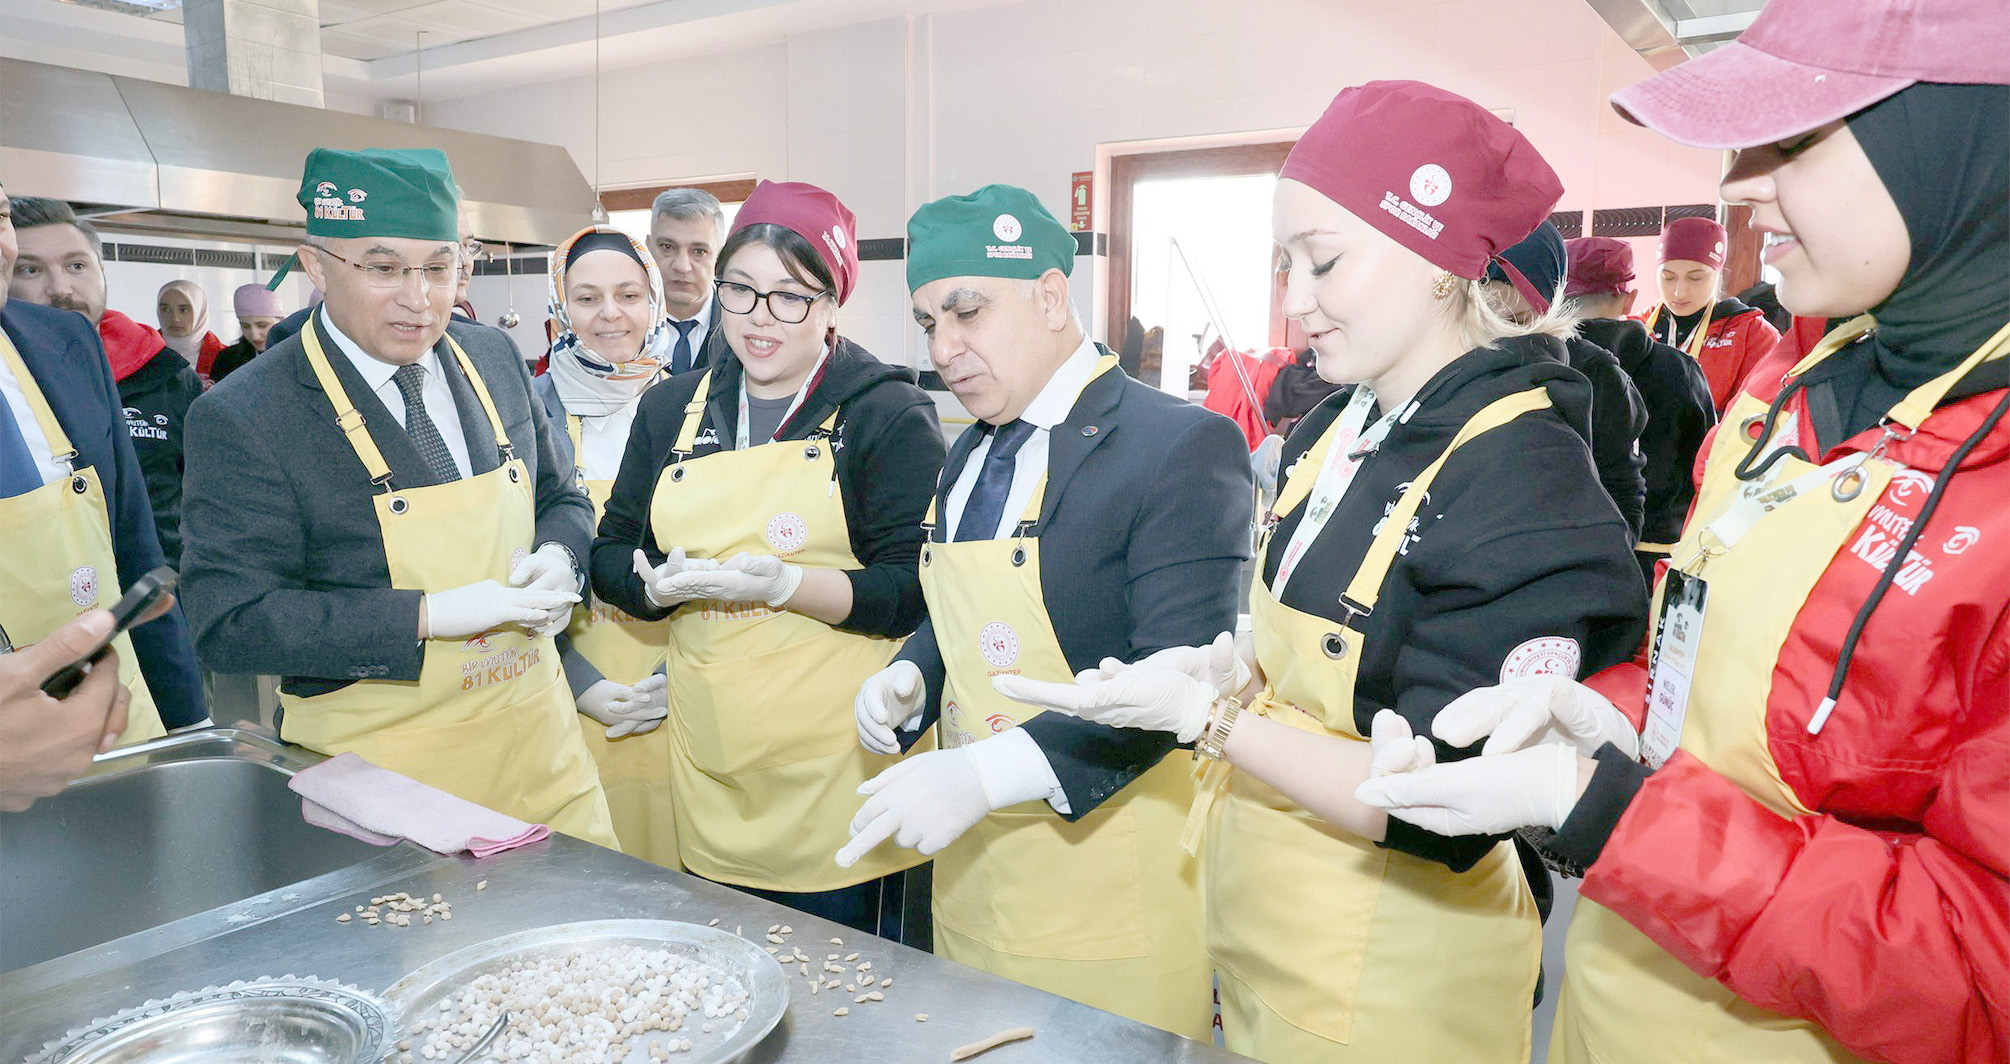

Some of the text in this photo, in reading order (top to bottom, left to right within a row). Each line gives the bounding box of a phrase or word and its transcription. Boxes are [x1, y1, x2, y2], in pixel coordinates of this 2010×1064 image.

[129, 426, 168, 440] KÜLTÜR
[461, 648, 541, 691] 81 KÜLTÜR
